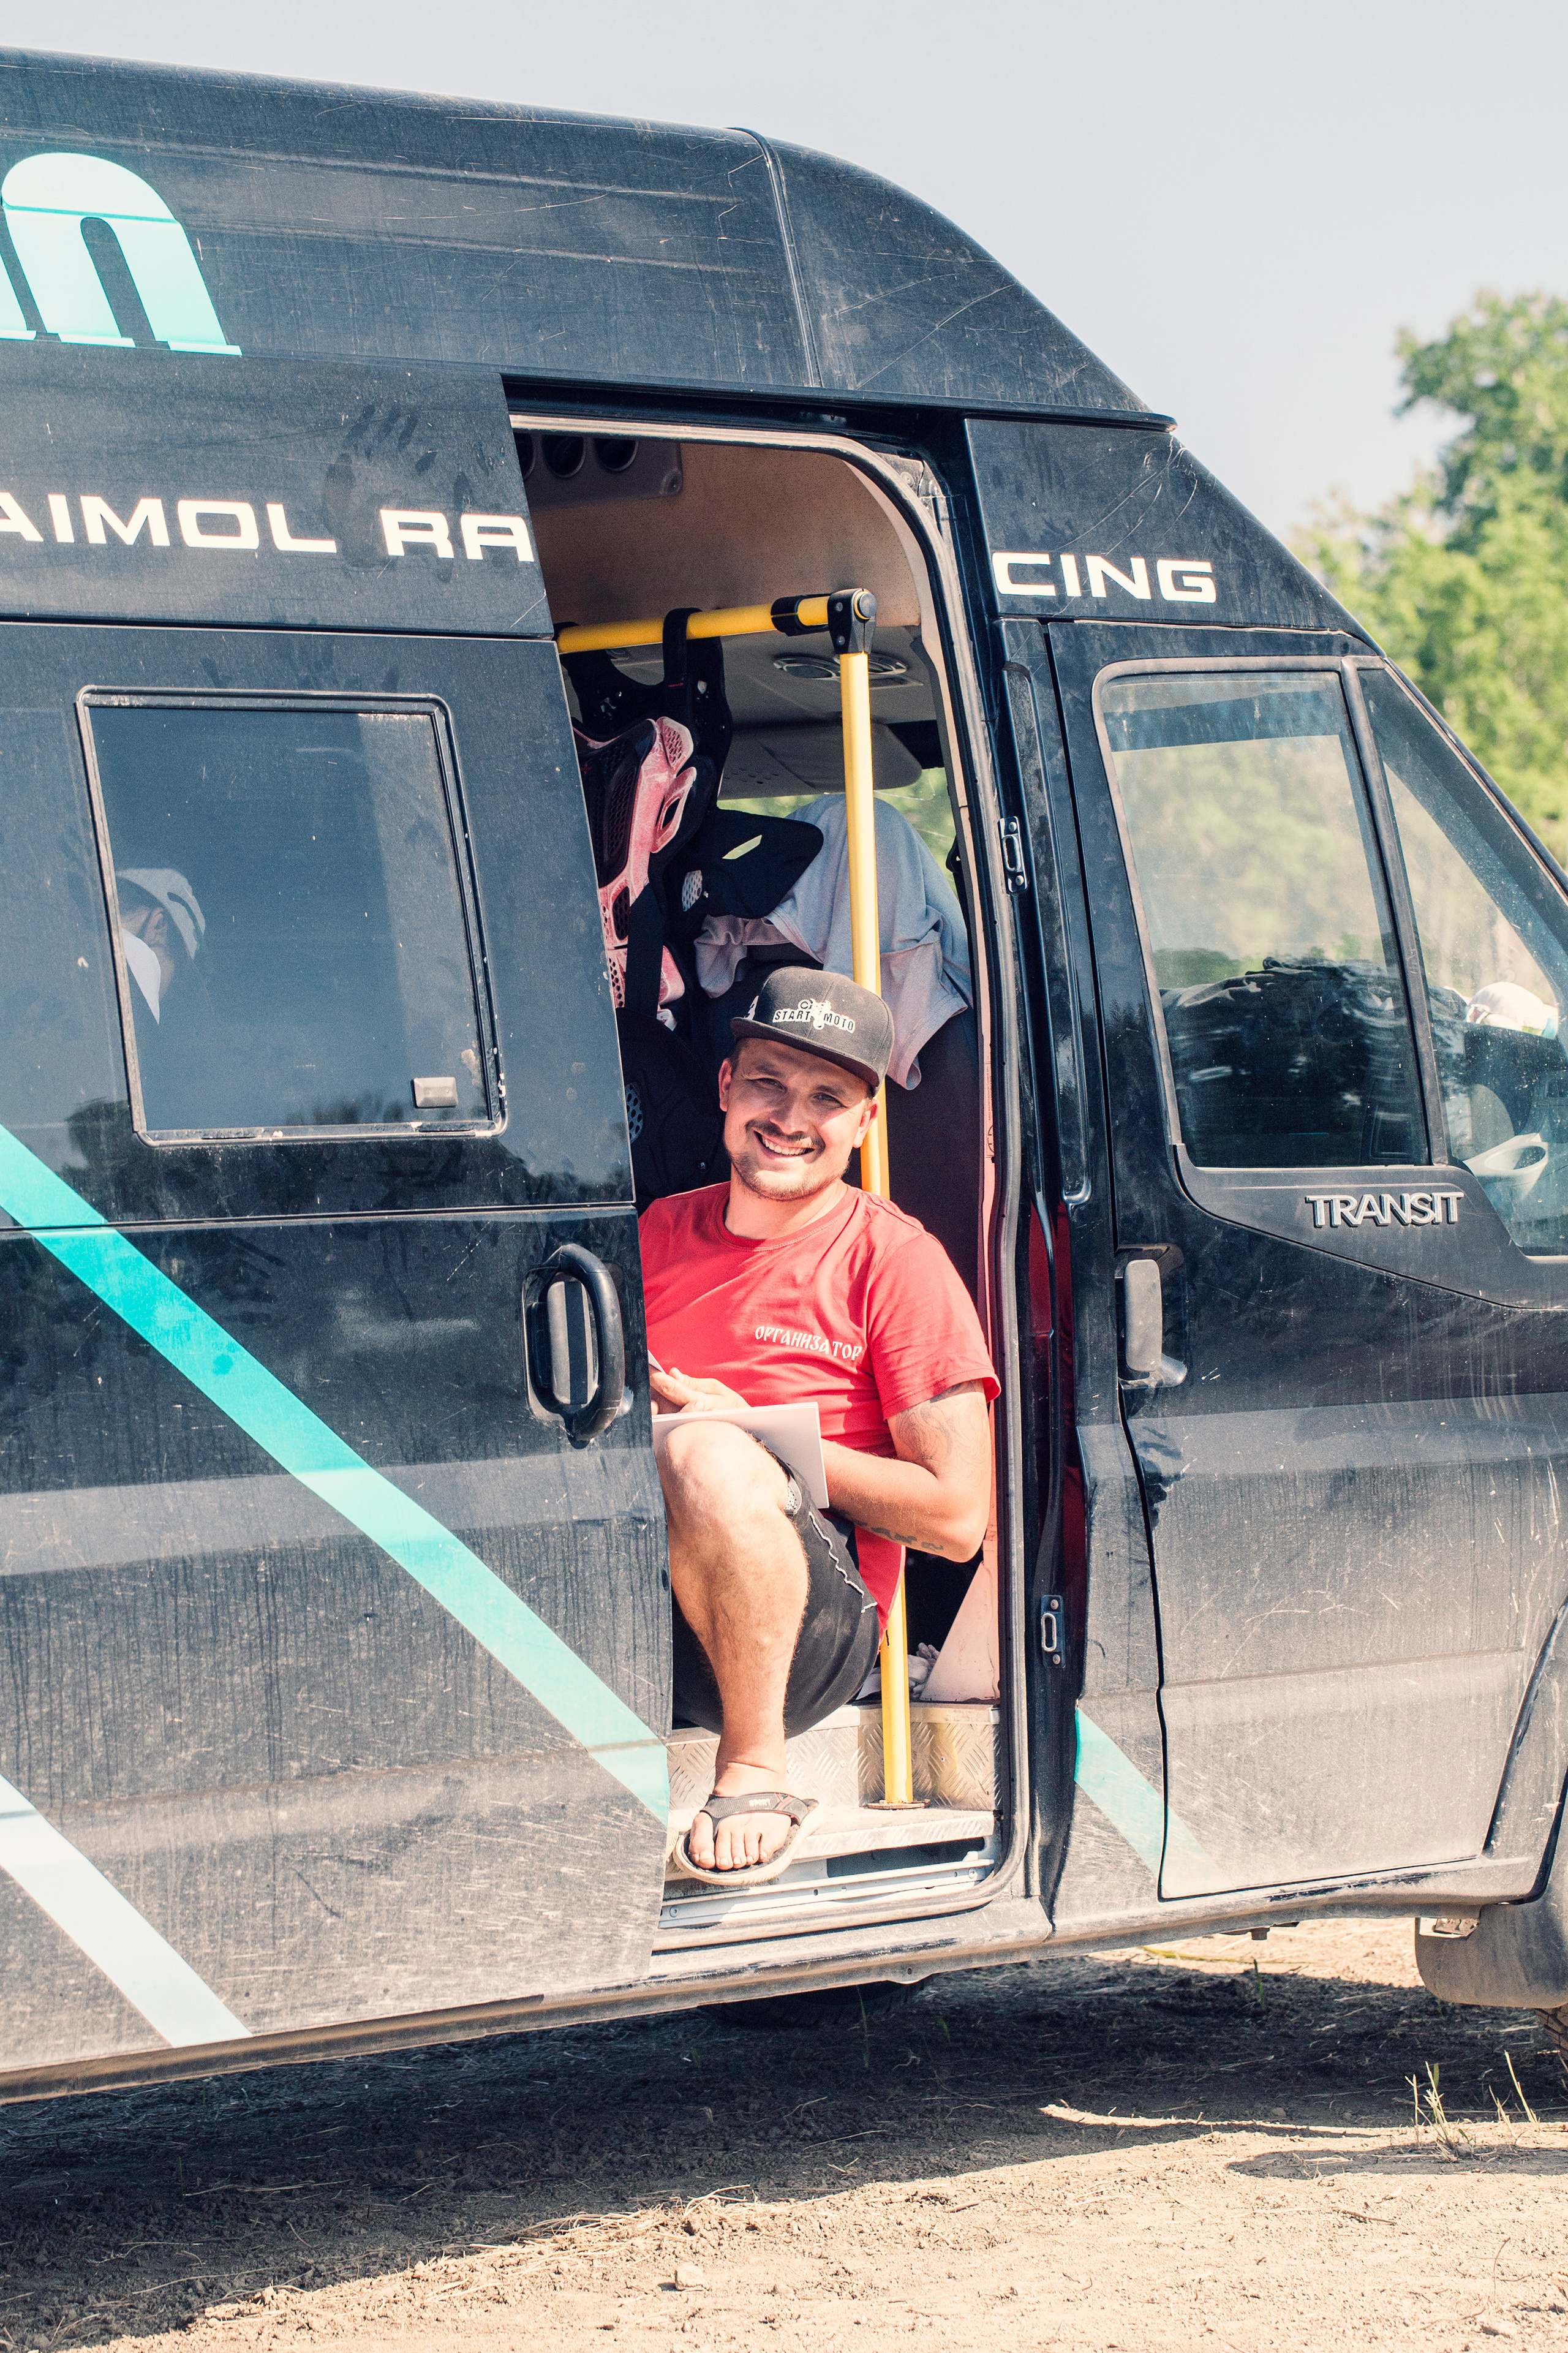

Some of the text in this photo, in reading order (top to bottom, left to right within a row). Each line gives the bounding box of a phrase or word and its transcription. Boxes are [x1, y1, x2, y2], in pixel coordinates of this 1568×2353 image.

[0, 491, 535, 562] AIMOL RA
[992, 552, 1217, 603] CING
[774, 1010, 854, 1032] START MOTO
[1304, 1192, 1465, 1228] TRANSIT
[755, 1325, 863, 1361] ОРГАНИЗАТОР
